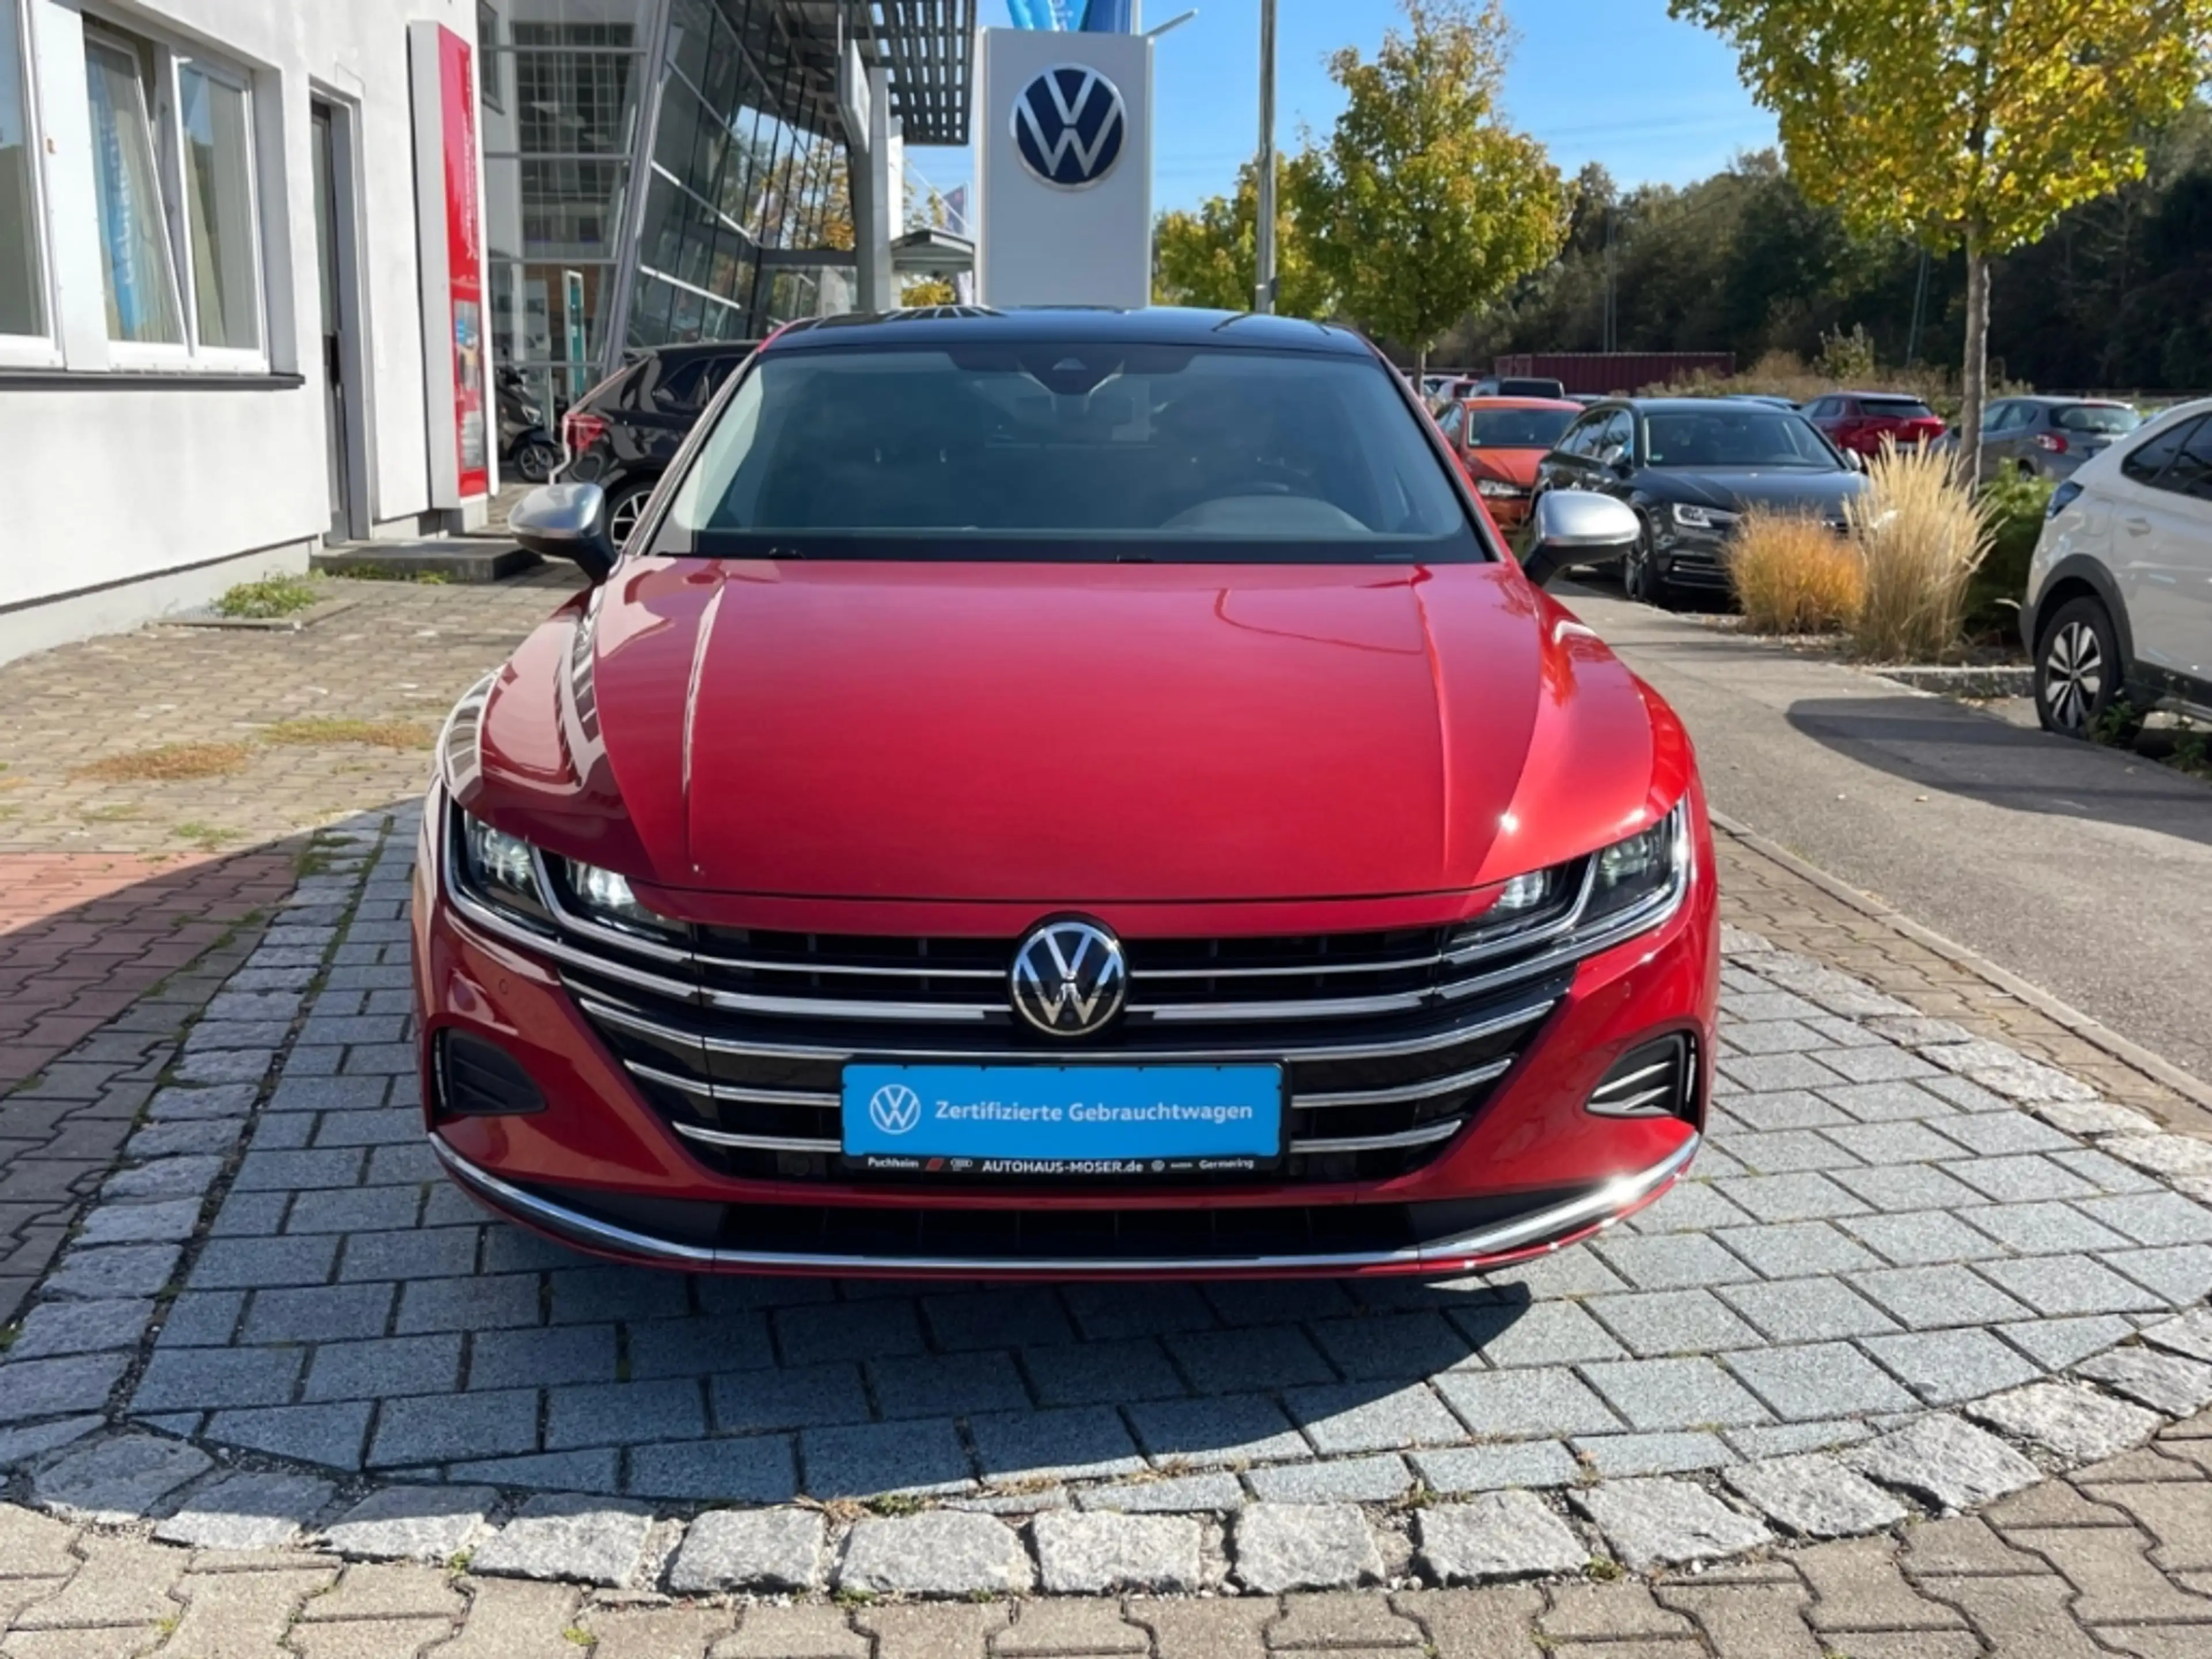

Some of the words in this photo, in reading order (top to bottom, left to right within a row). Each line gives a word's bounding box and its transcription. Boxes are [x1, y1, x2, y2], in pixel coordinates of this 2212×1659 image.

[935, 1100, 1063, 1122] Zertifizierte
[1069, 1102, 1253, 1124] Gebrauchtwagen
[982, 1160, 1143, 1173] AUTOHAUS-MOSER.de
[1198, 1158, 1254, 1170] Germering
